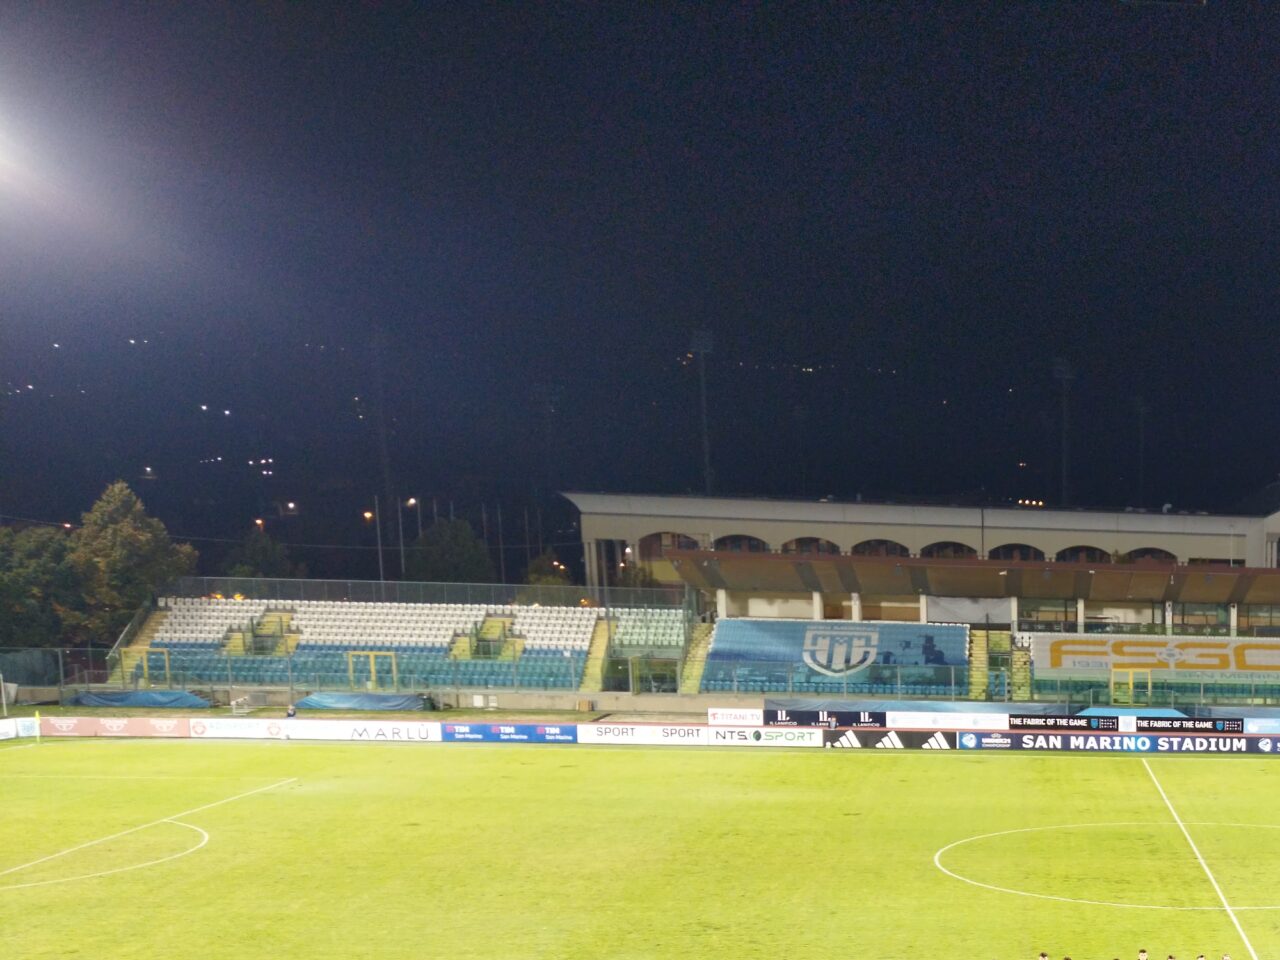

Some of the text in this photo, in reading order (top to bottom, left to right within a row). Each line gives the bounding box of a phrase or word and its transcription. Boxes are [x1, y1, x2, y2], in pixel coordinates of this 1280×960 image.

[1010, 717, 1023, 725] THE
[1023, 718, 1046, 726] FABRIC
[1047, 718, 1056, 726] OF
[1069, 719, 1088, 727] GAME
[1150, 720, 1172, 728] FABRIC
[1195, 721, 1213, 729] GAME
[597, 727, 635, 737] SPORT
[662, 728, 700, 738] SPORT
[716, 730, 815, 741] NTS SPORT
[1022, 734, 1246, 752] SAN MARINO STADIUM
